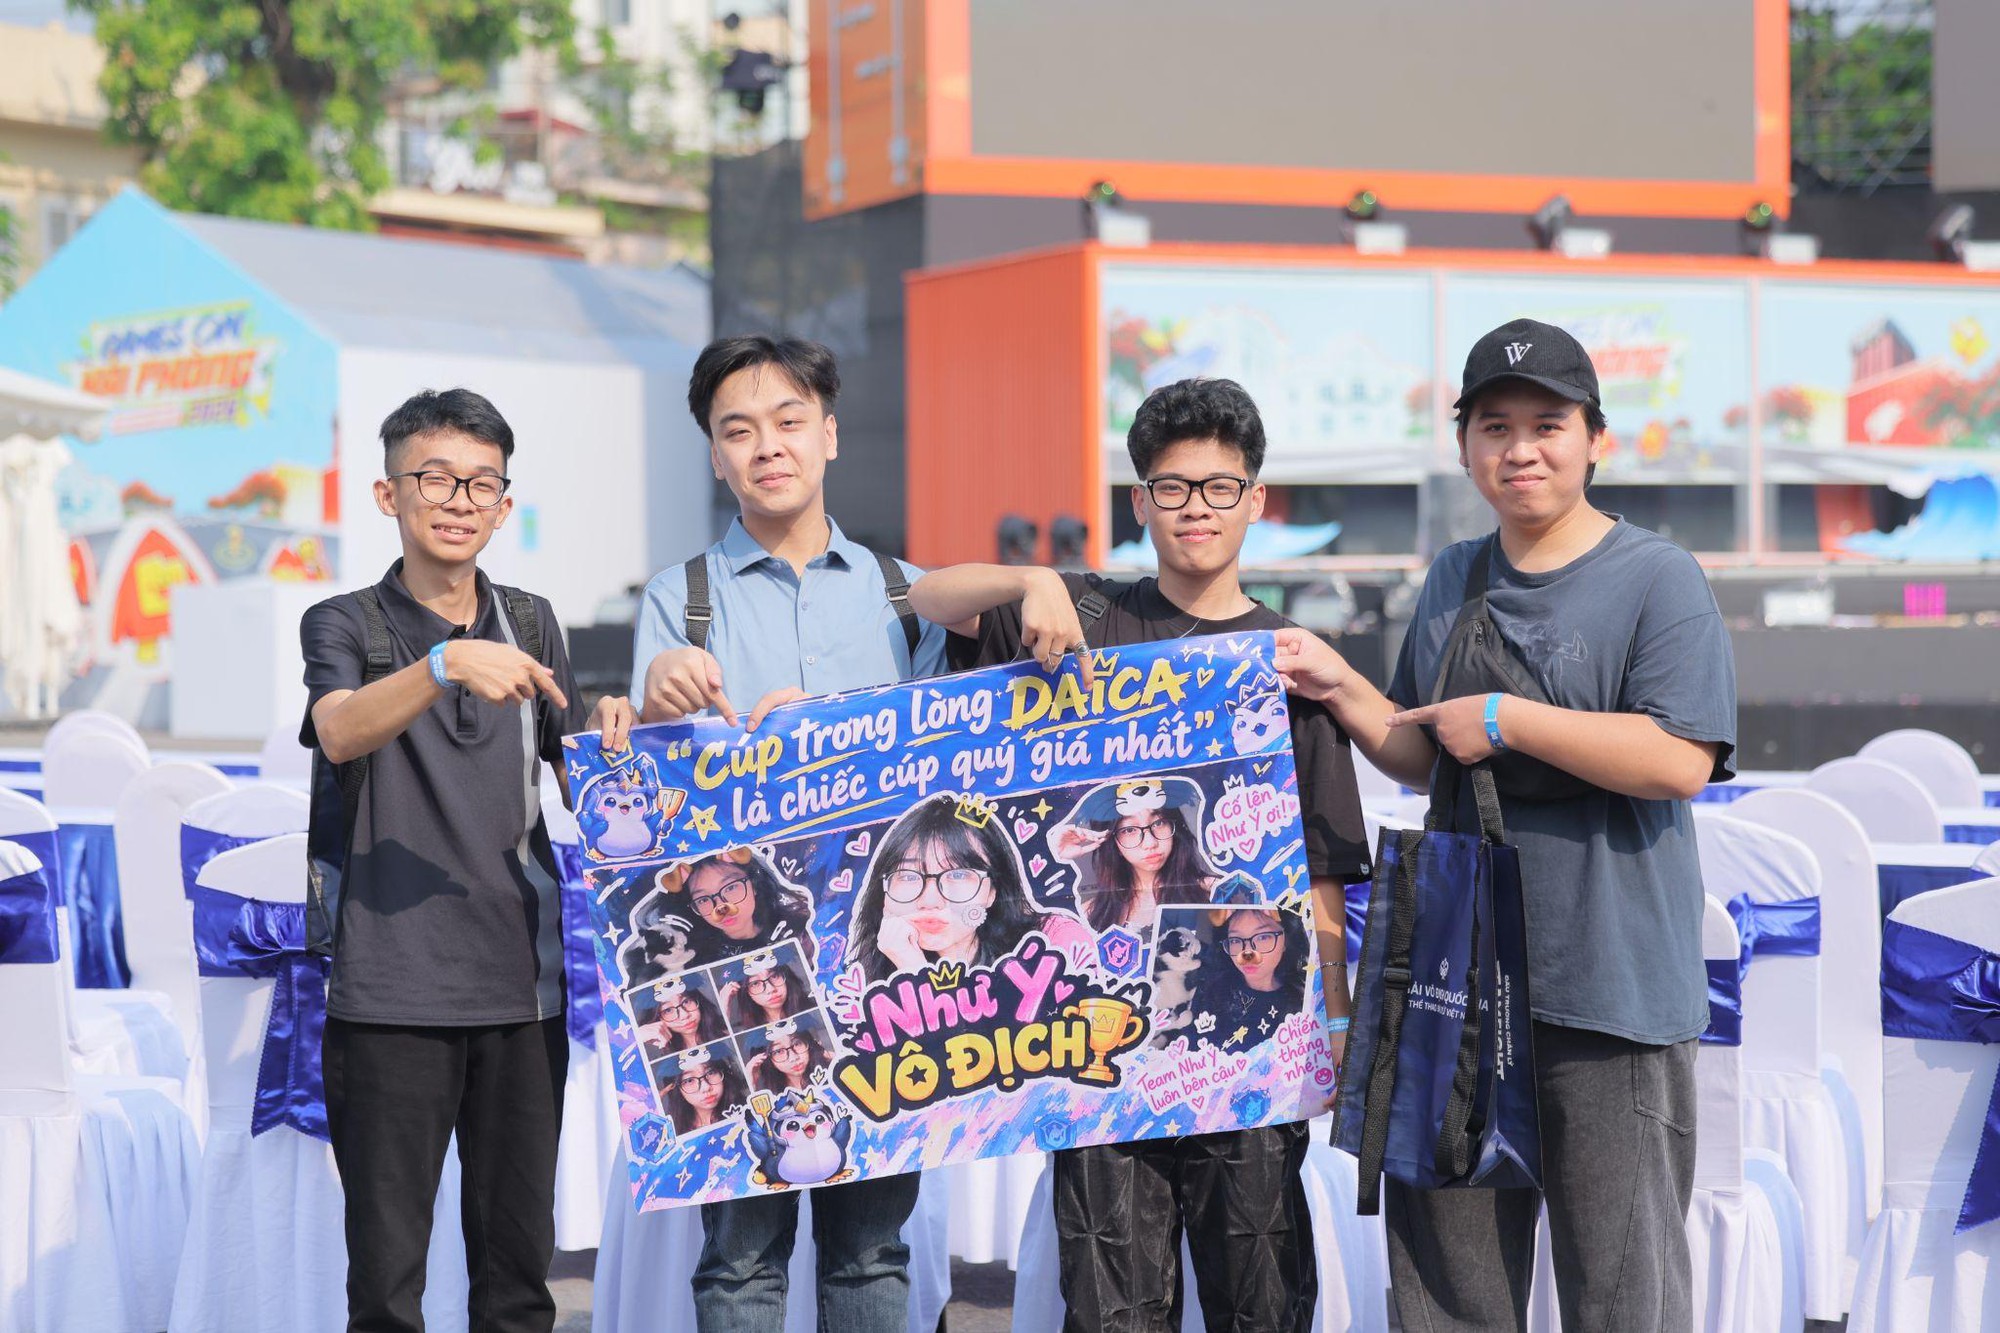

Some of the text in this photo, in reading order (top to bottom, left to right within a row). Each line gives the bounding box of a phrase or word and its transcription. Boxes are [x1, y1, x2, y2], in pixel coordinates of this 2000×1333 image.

[790, 708, 897, 763] trong
[911, 689, 992, 735] lòng
[733, 787, 771, 831] là
[779, 765, 867, 821] chiếc
[879, 753, 939, 796] cúp
[951, 736, 1015, 787] quý
[1030, 730, 1091, 780] giá
[1211, 799, 1288, 847] Như Ý ơi!
[1221, 790, 1272, 819] Cố lên
[870, 942, 1059, 1047] Như Ý
[1277, 1014, 1320, 1045] Chiến
[1278, 1037, 1324, 1063] thắng
[840, 1020, 1086, 1117] VÔ ĐỊCH
[1137, 1069, 1176, 1094] Team
[1178, 1056, 1206, 1079] Như
[1151, 1065, 1237, 1112] luôn bên cậu
[1284, 1053, 1320, 1082] nhé!
